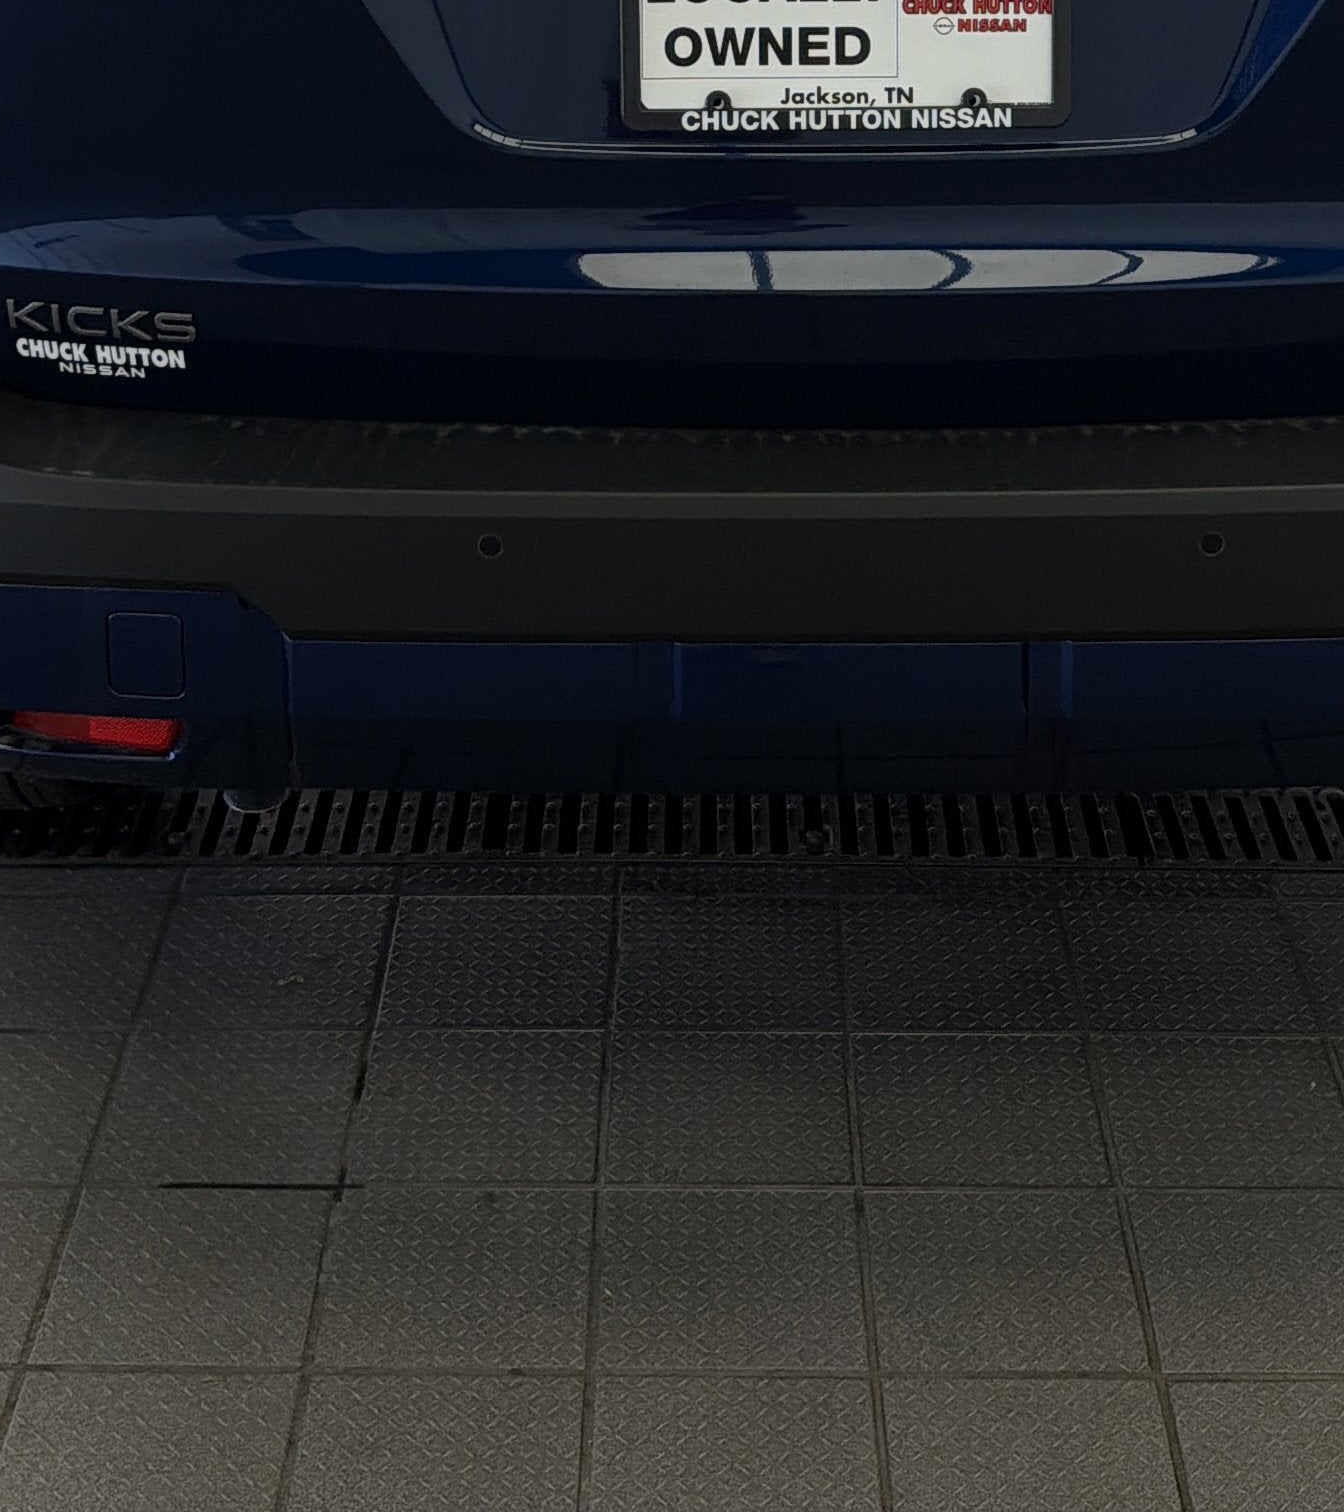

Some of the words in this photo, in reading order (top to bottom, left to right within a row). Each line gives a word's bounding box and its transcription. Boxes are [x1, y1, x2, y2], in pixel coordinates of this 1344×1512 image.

[958, 18, 1027, 33] NISSAN
[664, 26, 871, 67] OWNED
[780, 87, 876, 107] Jackson,
[884, 87, 914, 104] TN
[681, 110, 780, 131] CHUCK
[788, 108, 901, 131] HUTTON
[911, 107, 1012, 129] NISSAN
[5, 299, 197, 343] KICKS
[16, 338, 89, 363] CHUCK
[95, 345, 186, 369] HUTTON
[59, 362, 146, 379] NISSAN
